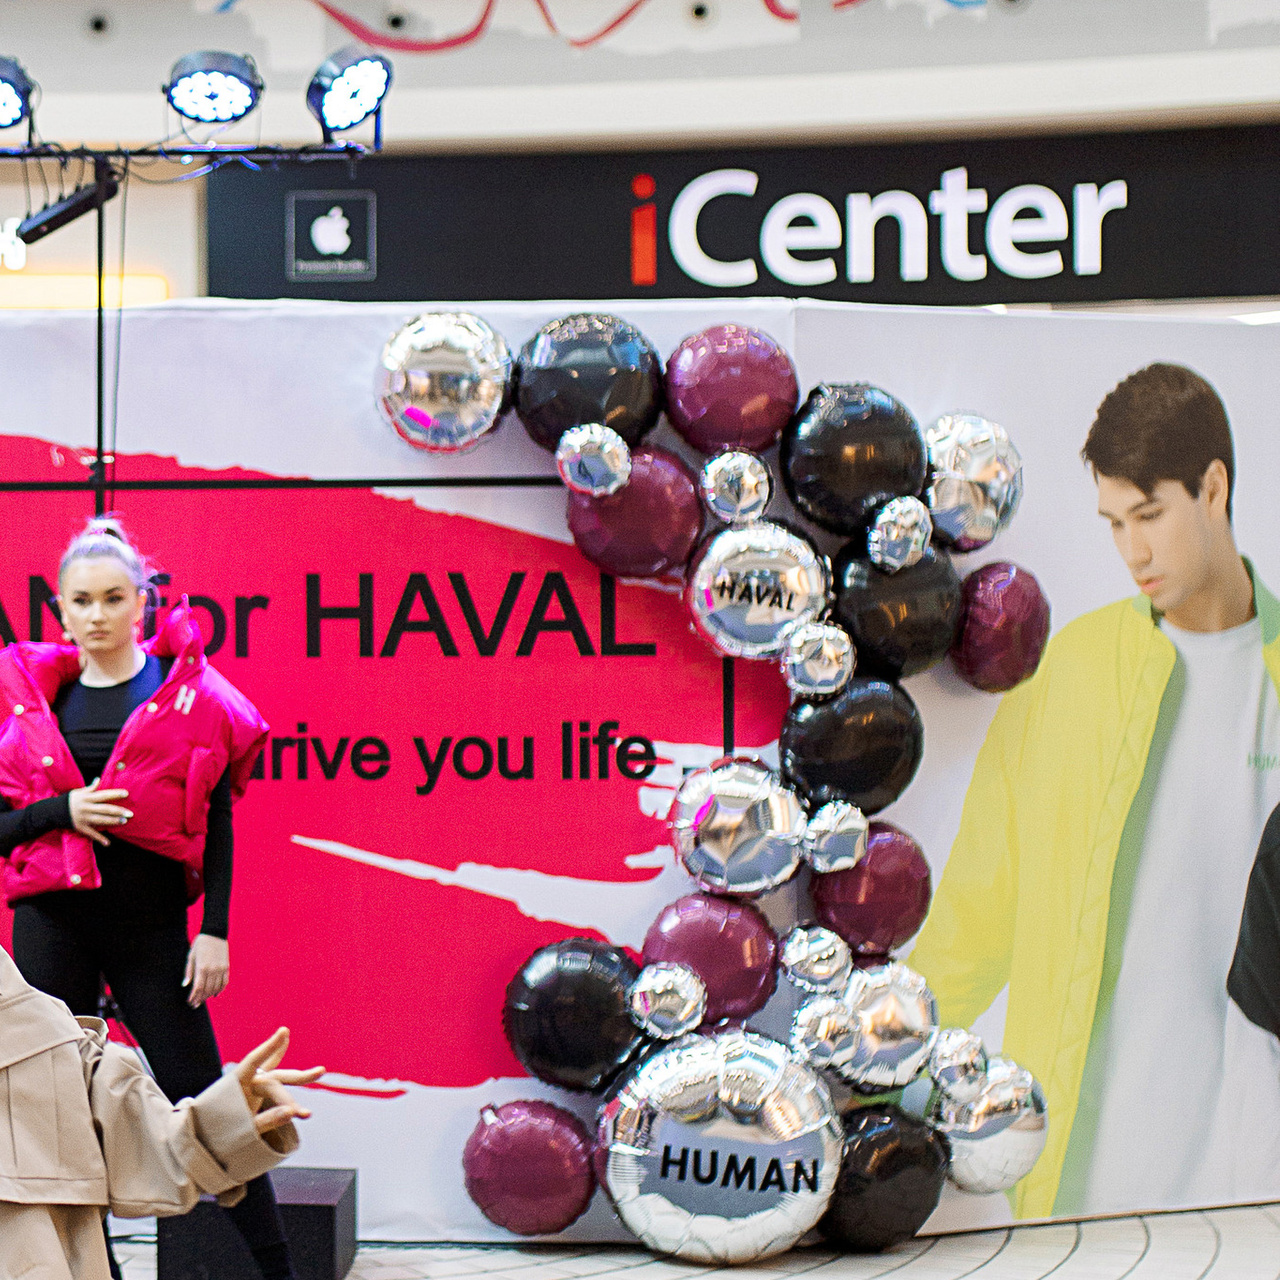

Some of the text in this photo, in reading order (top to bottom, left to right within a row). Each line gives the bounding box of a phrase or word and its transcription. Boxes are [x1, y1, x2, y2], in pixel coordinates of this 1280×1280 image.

[631, 167, 1128, 287] iCenter
[306, 572, 656, 658] HAVAL
[716, 579, 795, 611] HAVAL
[173, 684, 196, 715] H
[413, 736, 534, 796] you
[562, 721, 657, 780] life
[661, 1144, 819, 1193] HUMAN
